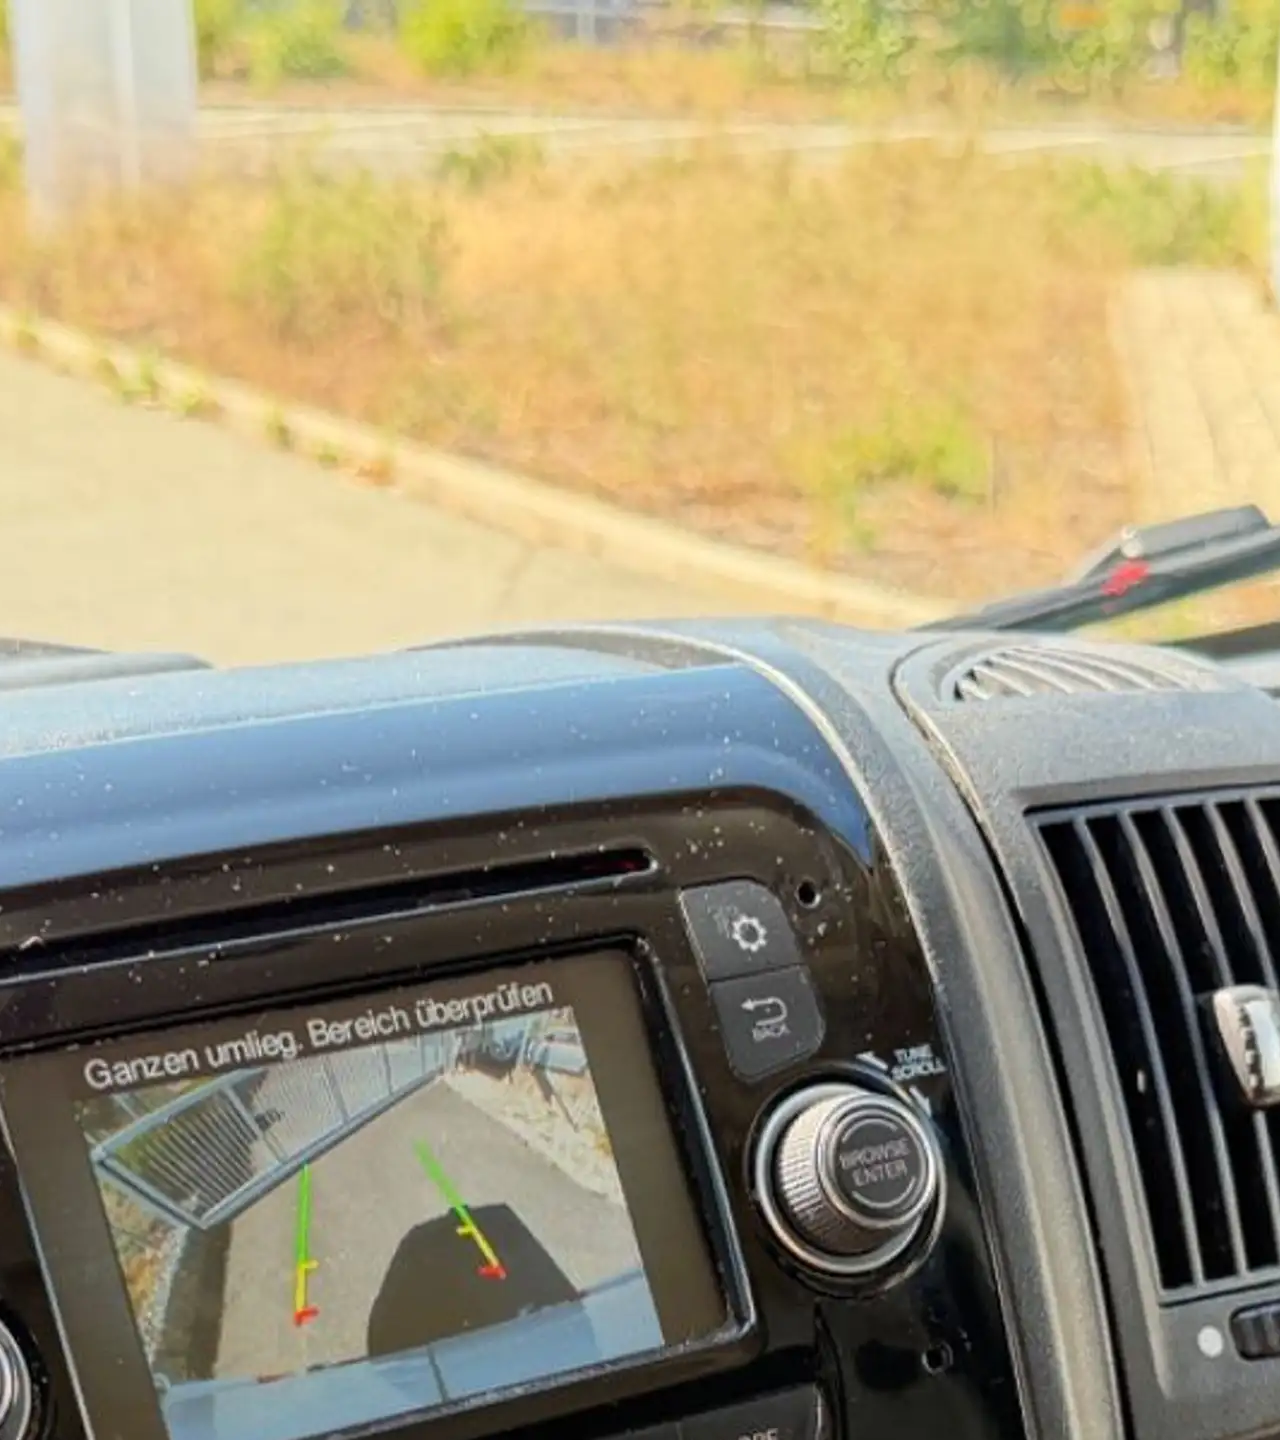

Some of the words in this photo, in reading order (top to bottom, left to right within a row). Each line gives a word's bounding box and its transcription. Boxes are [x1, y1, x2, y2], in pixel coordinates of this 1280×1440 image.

[83, 1044, 200, 1091] Ganzen
[204, 1025, 304, 1071] umlieg.
[307, 1003, 411, 1048] Bereich
[416, 980, 553, 1030] überprüfen
[839, 1138, 910, 1170] BROWSE
[853, 1159, 908, 1187] ENTER
